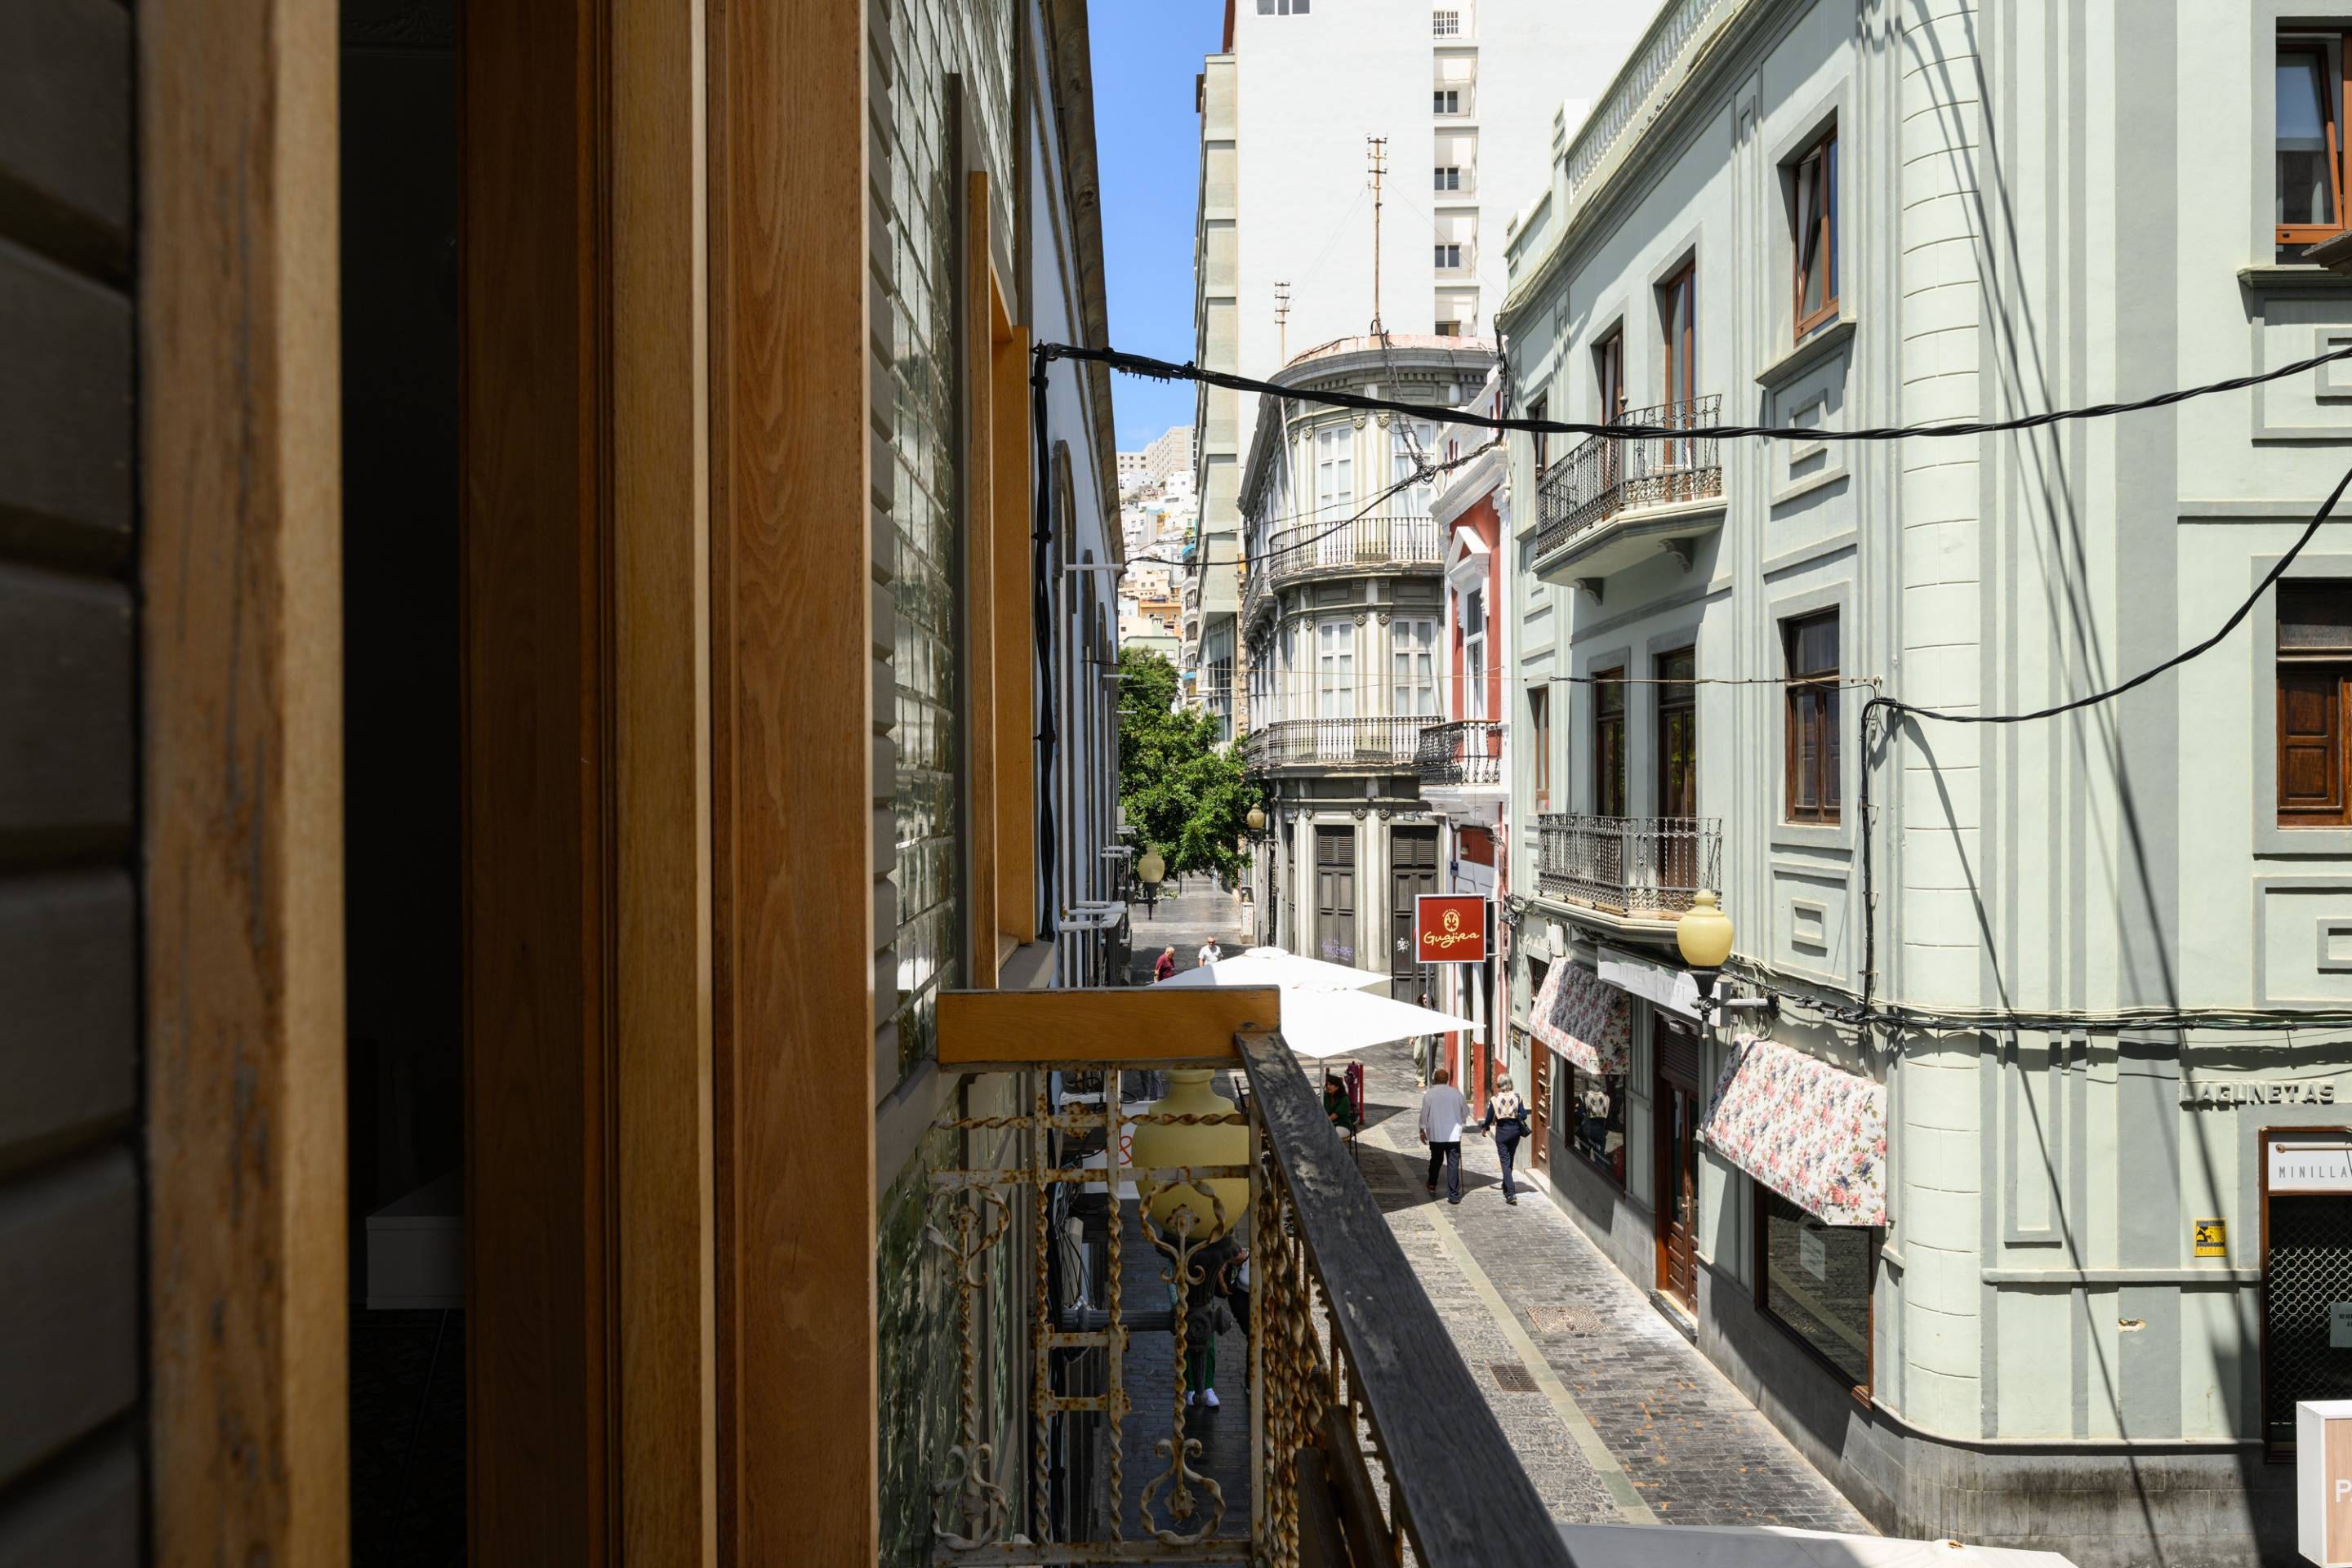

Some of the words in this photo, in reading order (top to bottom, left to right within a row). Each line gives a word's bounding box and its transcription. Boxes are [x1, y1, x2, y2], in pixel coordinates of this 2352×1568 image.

[1423, 931, 1479, 948] Guajira
[2180, 1081, 2334, 1103] LAGUNETAS
[2335, 1479, 2352, 1503] P
